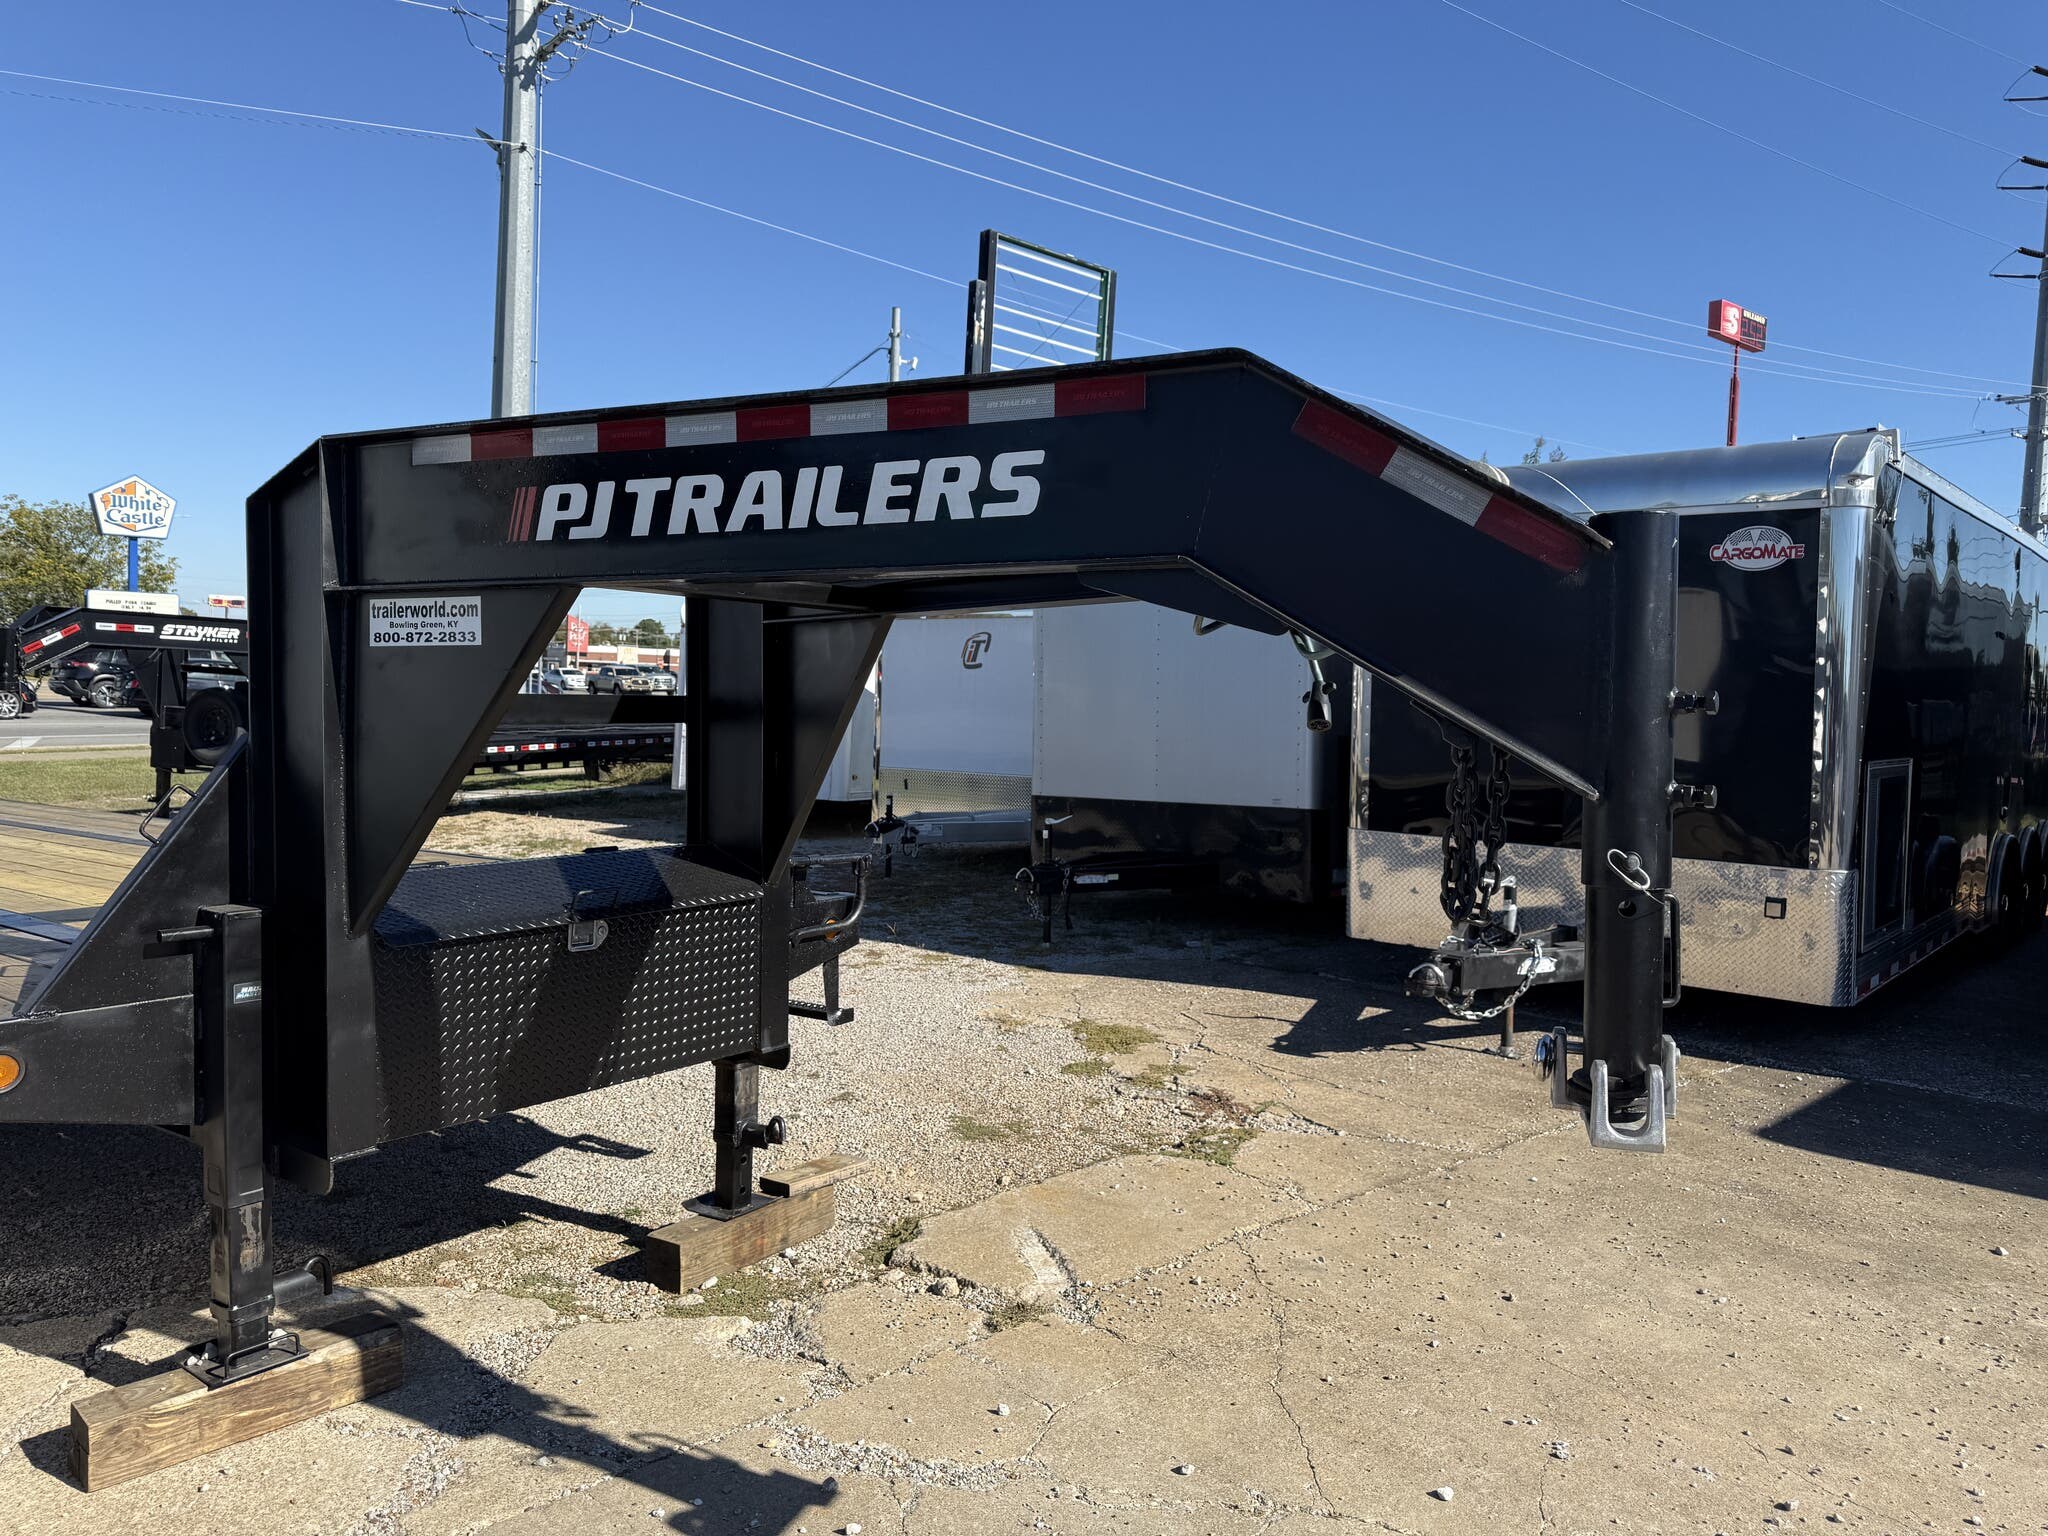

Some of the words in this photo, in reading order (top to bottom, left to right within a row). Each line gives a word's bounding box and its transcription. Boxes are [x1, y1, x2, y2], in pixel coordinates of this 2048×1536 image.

[624, 449, 1046, 537] TRAILERS
[110, 494, 162, 512] White
[106, 508, 164, 526] Castle
[371, 600, 479, 619] trailerworld.com
[160, 623, 241, 642] STRYKER
[390, 621, 419, 630] Bowling
[420, 621, 446, 630] Green,
[447, 620, 459, 628] KY
[373, 631, 477, 643] 800-872-2833
